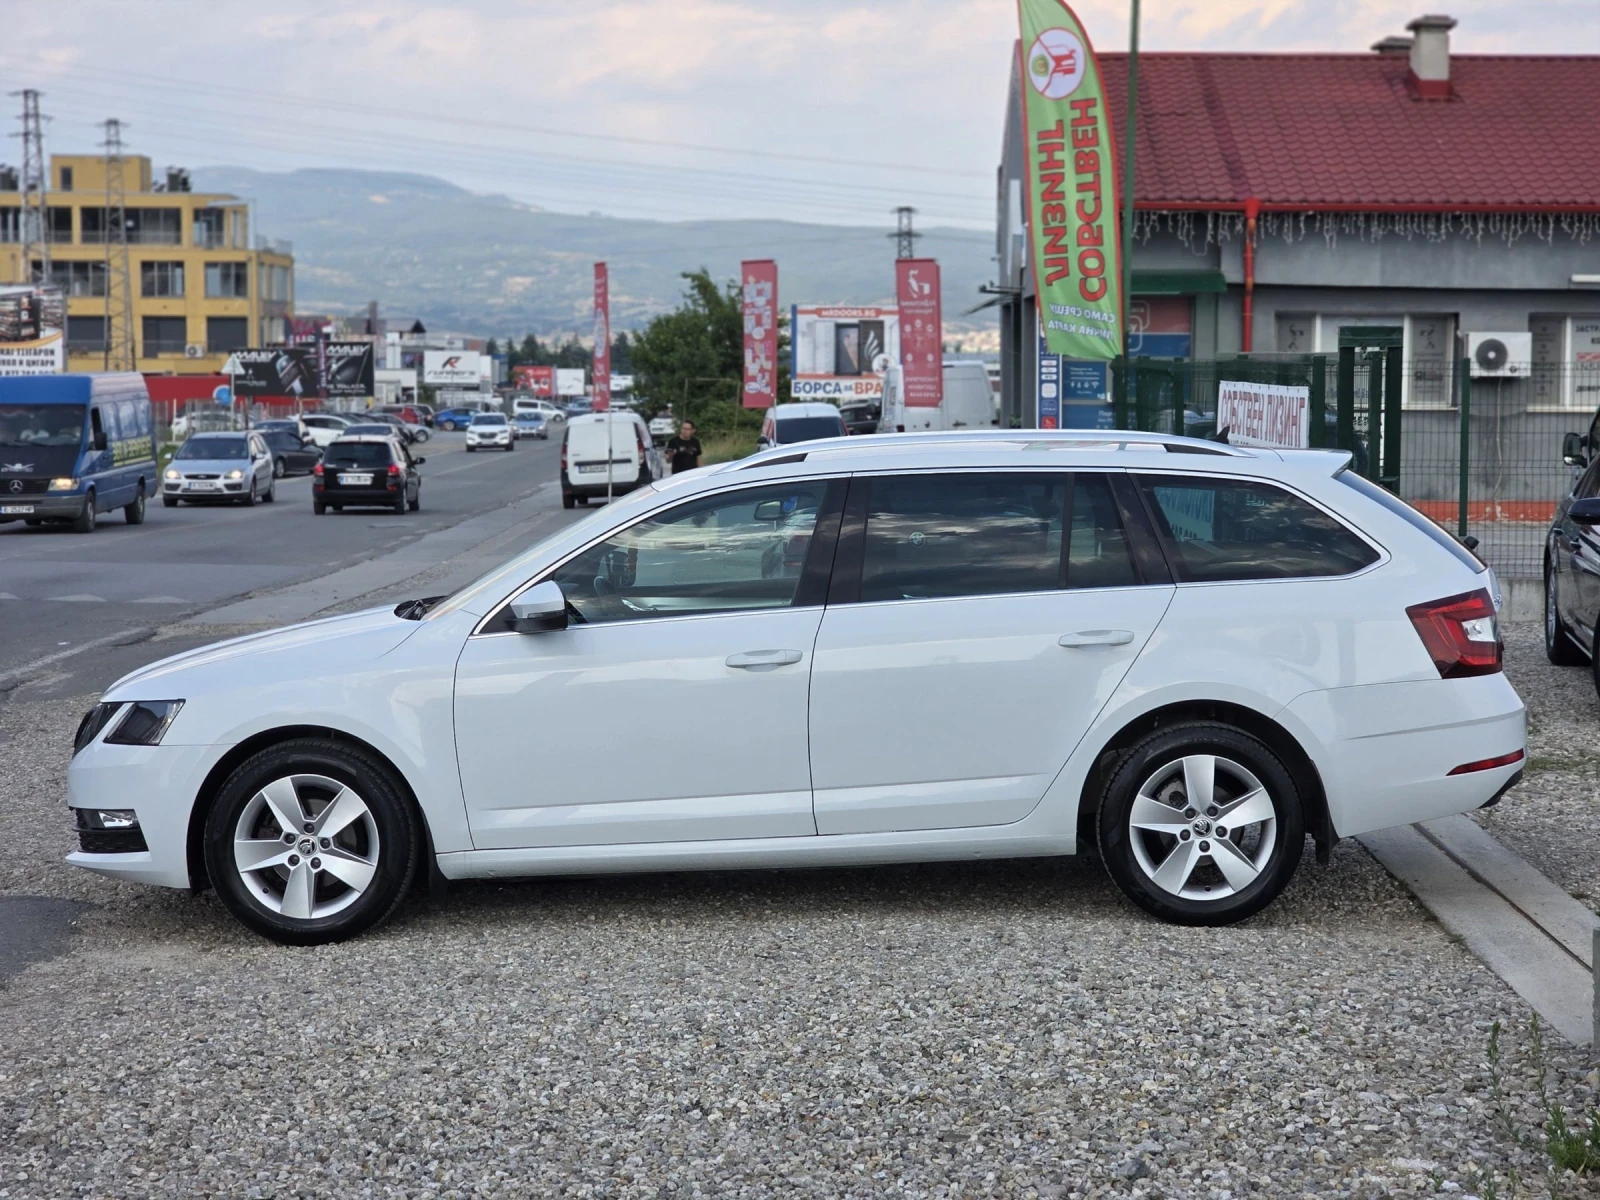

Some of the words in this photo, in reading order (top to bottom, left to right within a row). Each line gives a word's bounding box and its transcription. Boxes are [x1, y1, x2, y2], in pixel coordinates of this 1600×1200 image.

[793, 381, 843, 395] БОРСА
[854, 382, 883, 395] ВРА
[1221, 389, 1265, 440] СОБСТВЕН
[1264, 394, 1306, 448] ЛИЗИНГ
